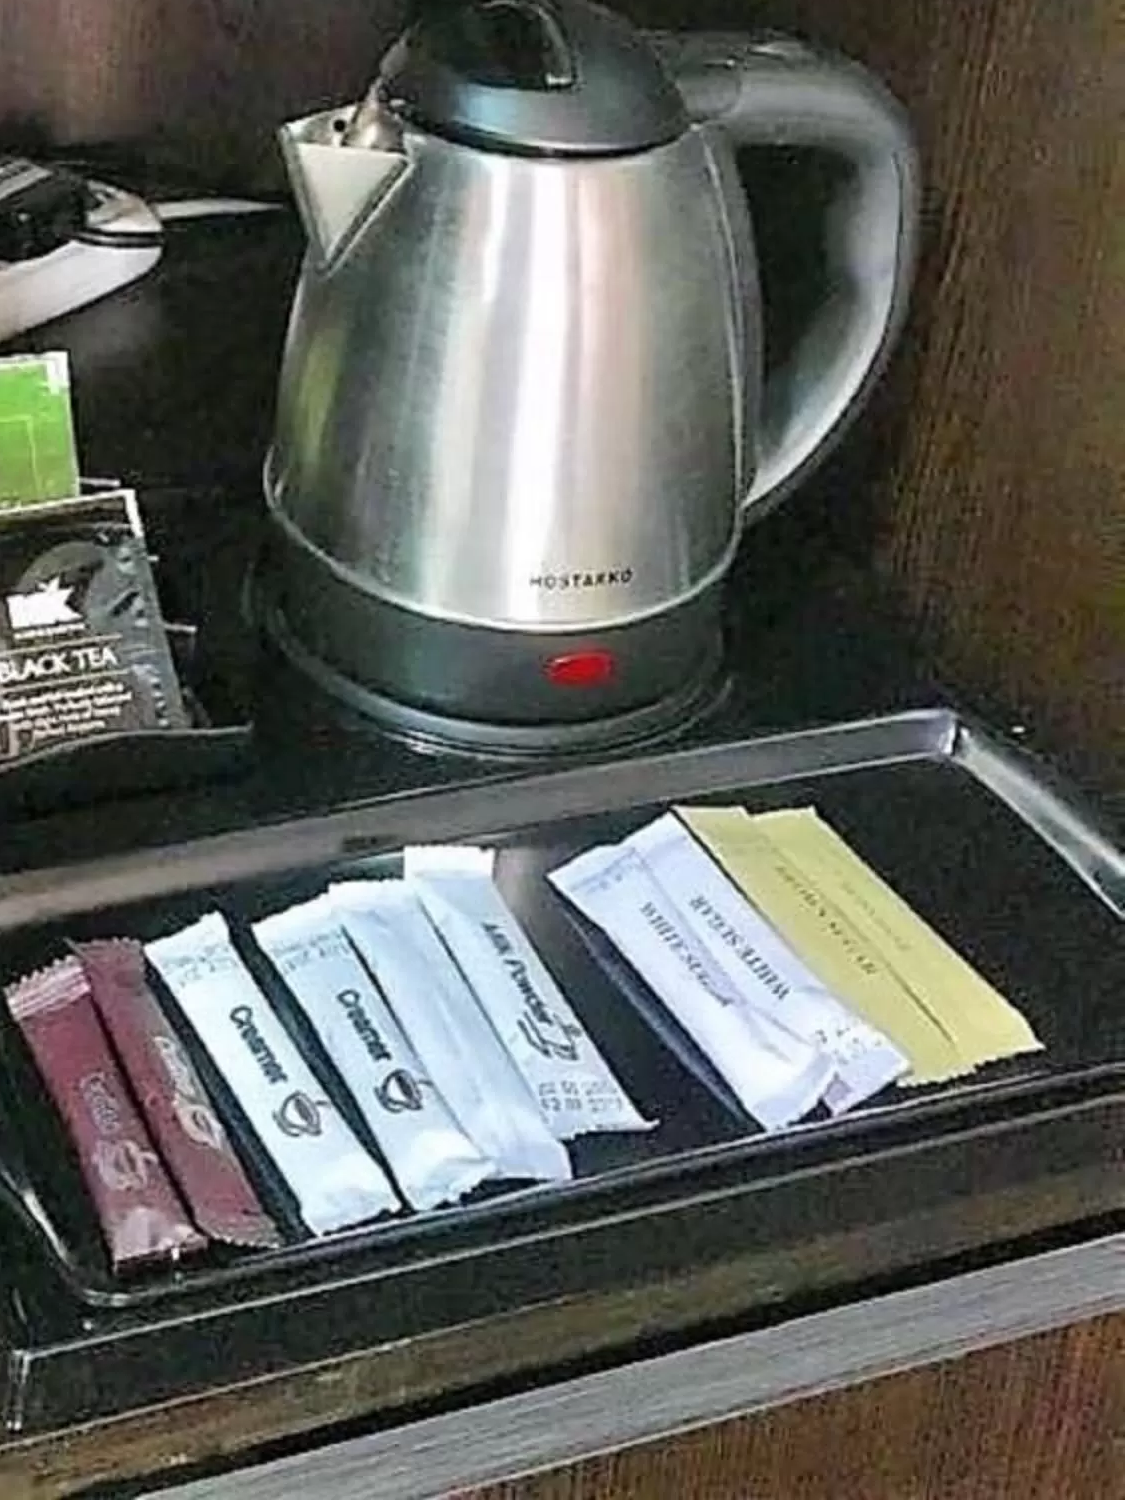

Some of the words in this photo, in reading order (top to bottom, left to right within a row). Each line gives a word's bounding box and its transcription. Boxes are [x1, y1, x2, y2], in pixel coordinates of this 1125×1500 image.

[73, 646, 119, 671] TEA
[689, 894, 745, 948] SUGAR
[737, 943, 791, 1001] WHITE
[228, 1003, 289, 1085] Creamer
[336, 987, 393, 1062] Creamer
